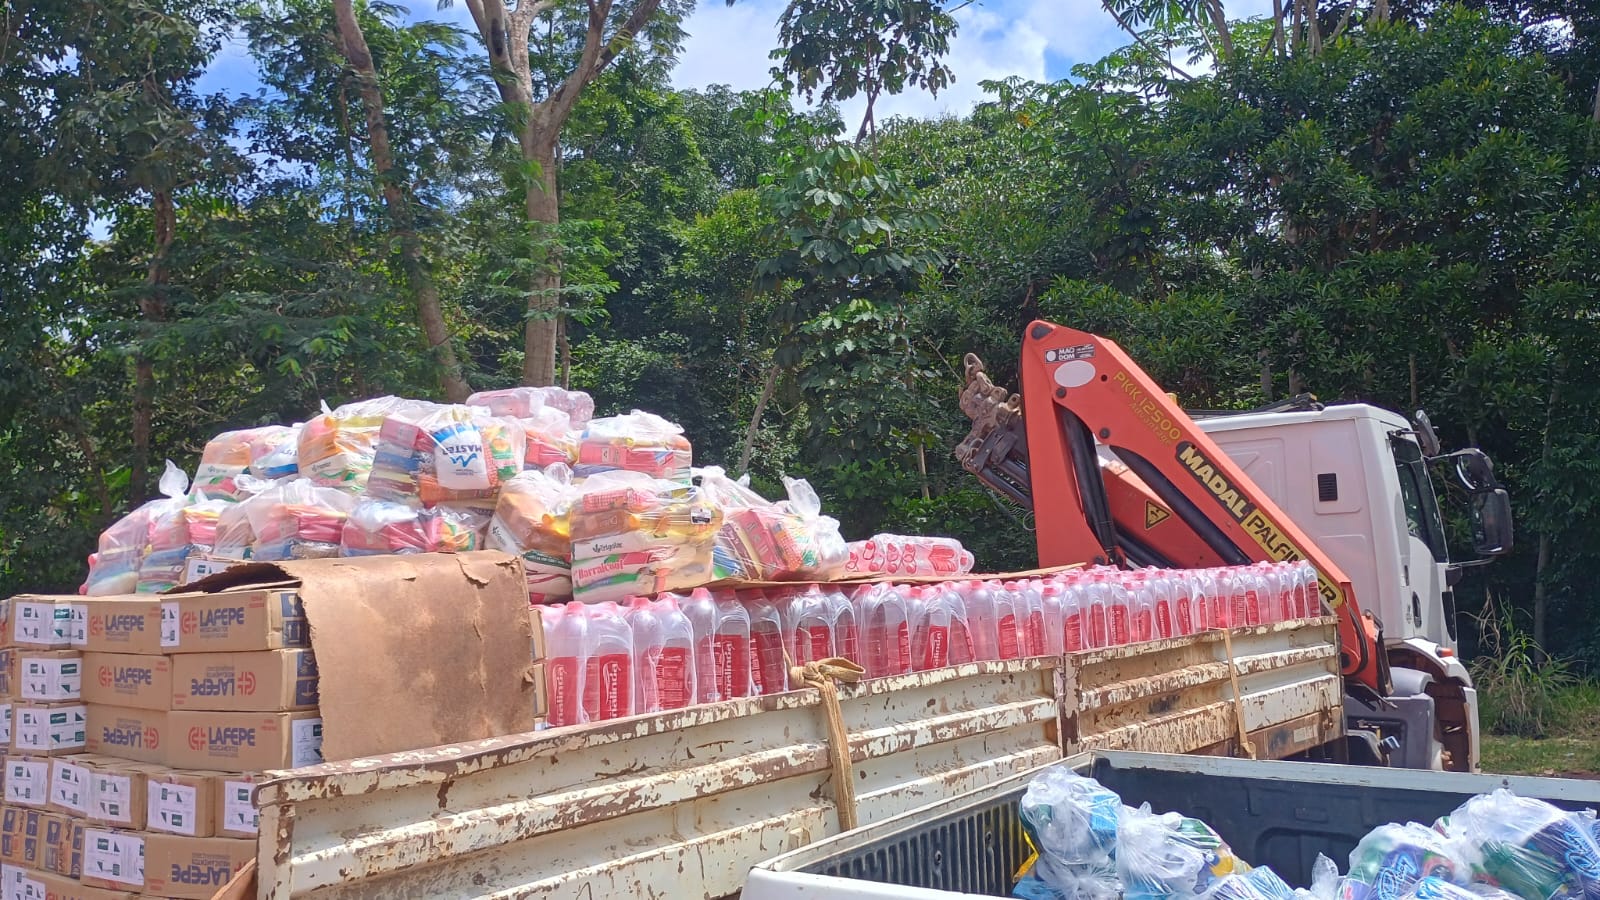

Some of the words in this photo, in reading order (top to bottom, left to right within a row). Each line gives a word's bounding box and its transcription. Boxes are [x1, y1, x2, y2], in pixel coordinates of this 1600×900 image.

[1112, 370, 1142, 400] PKK
[1137, 396, 1182, 442] 12500
[1176, 445, 1252, 519] MADAL
[105, 614, 145, 631] LAFEPE
[200, 607, 244, 627] LAFEPE
[113, 668, 152, 685] LAFEPE
[191, 678, 235, 696] LAFEPE
[103, 727, 142, 748] LAFEPE
[208, 727, 256, 746] LAFEPE
[172, 863, 230, 884] LAFEPE
